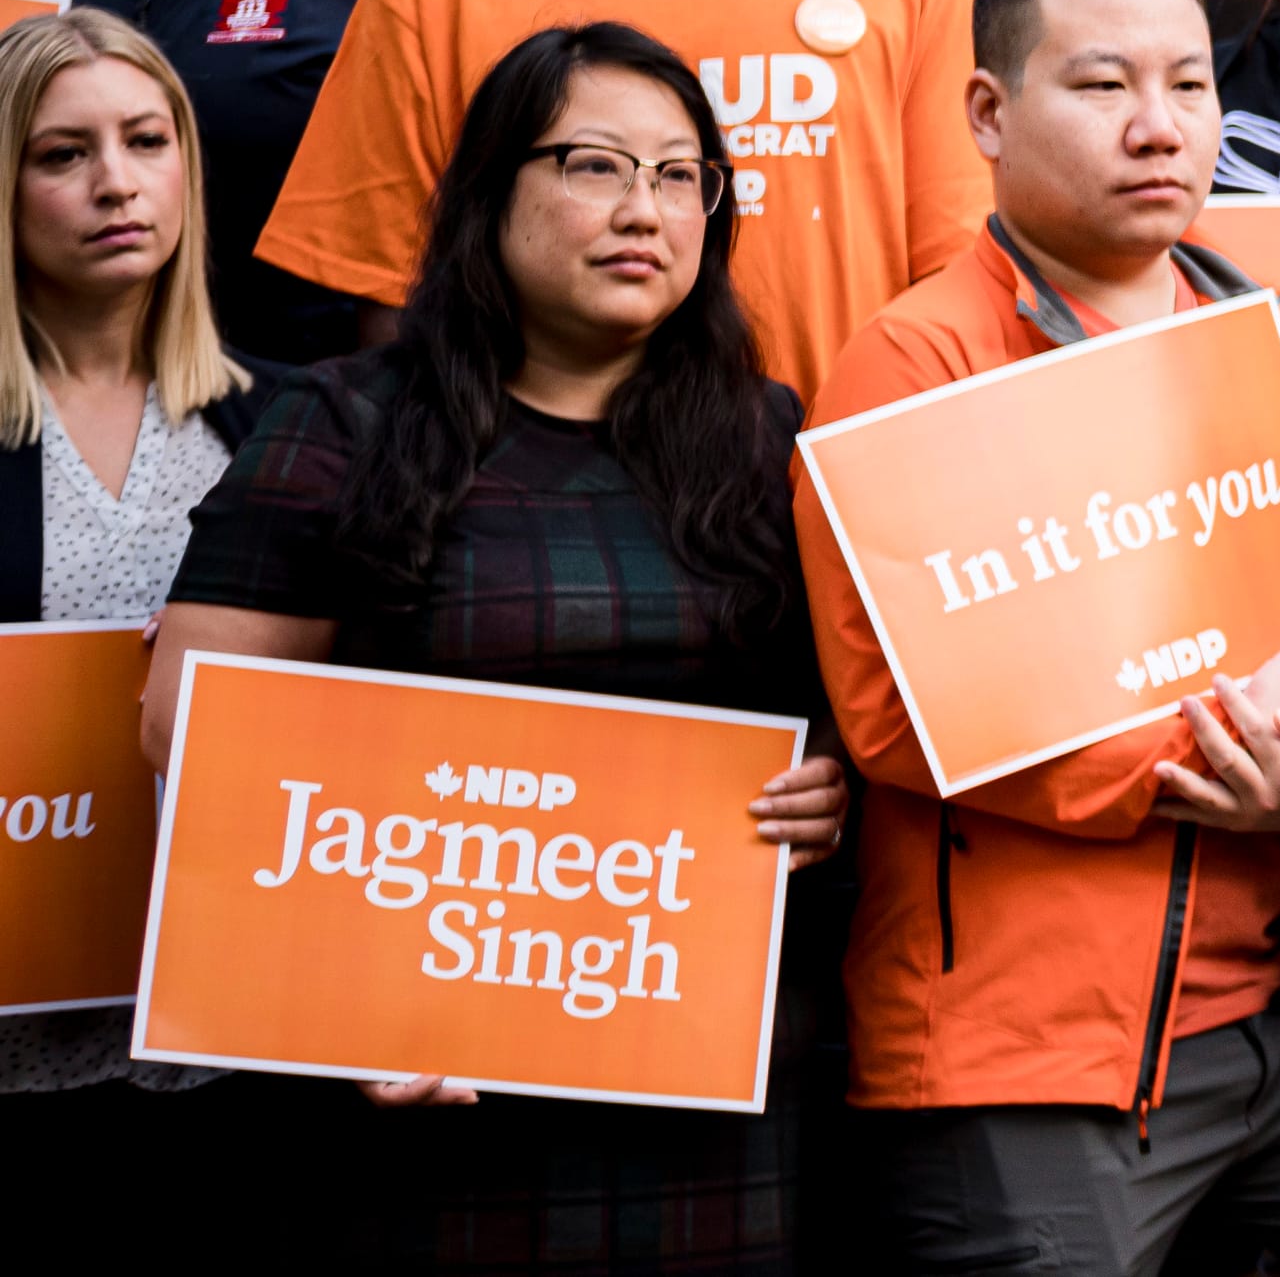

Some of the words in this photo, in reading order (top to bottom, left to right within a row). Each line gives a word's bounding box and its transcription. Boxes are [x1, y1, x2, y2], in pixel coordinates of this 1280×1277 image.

[924, 549, 1018, 614] In
[1017, 516, 1081, 583] it
[1084, 489, 1178, 560] for
[1143, 628, 1228, 689] NDP
[0, 792, 97, 843] ou
[464, 765, 577, 811] NDP
[253, 778, 695, 913] Jagmeet
[421, 899, 681, 1019] Singh
